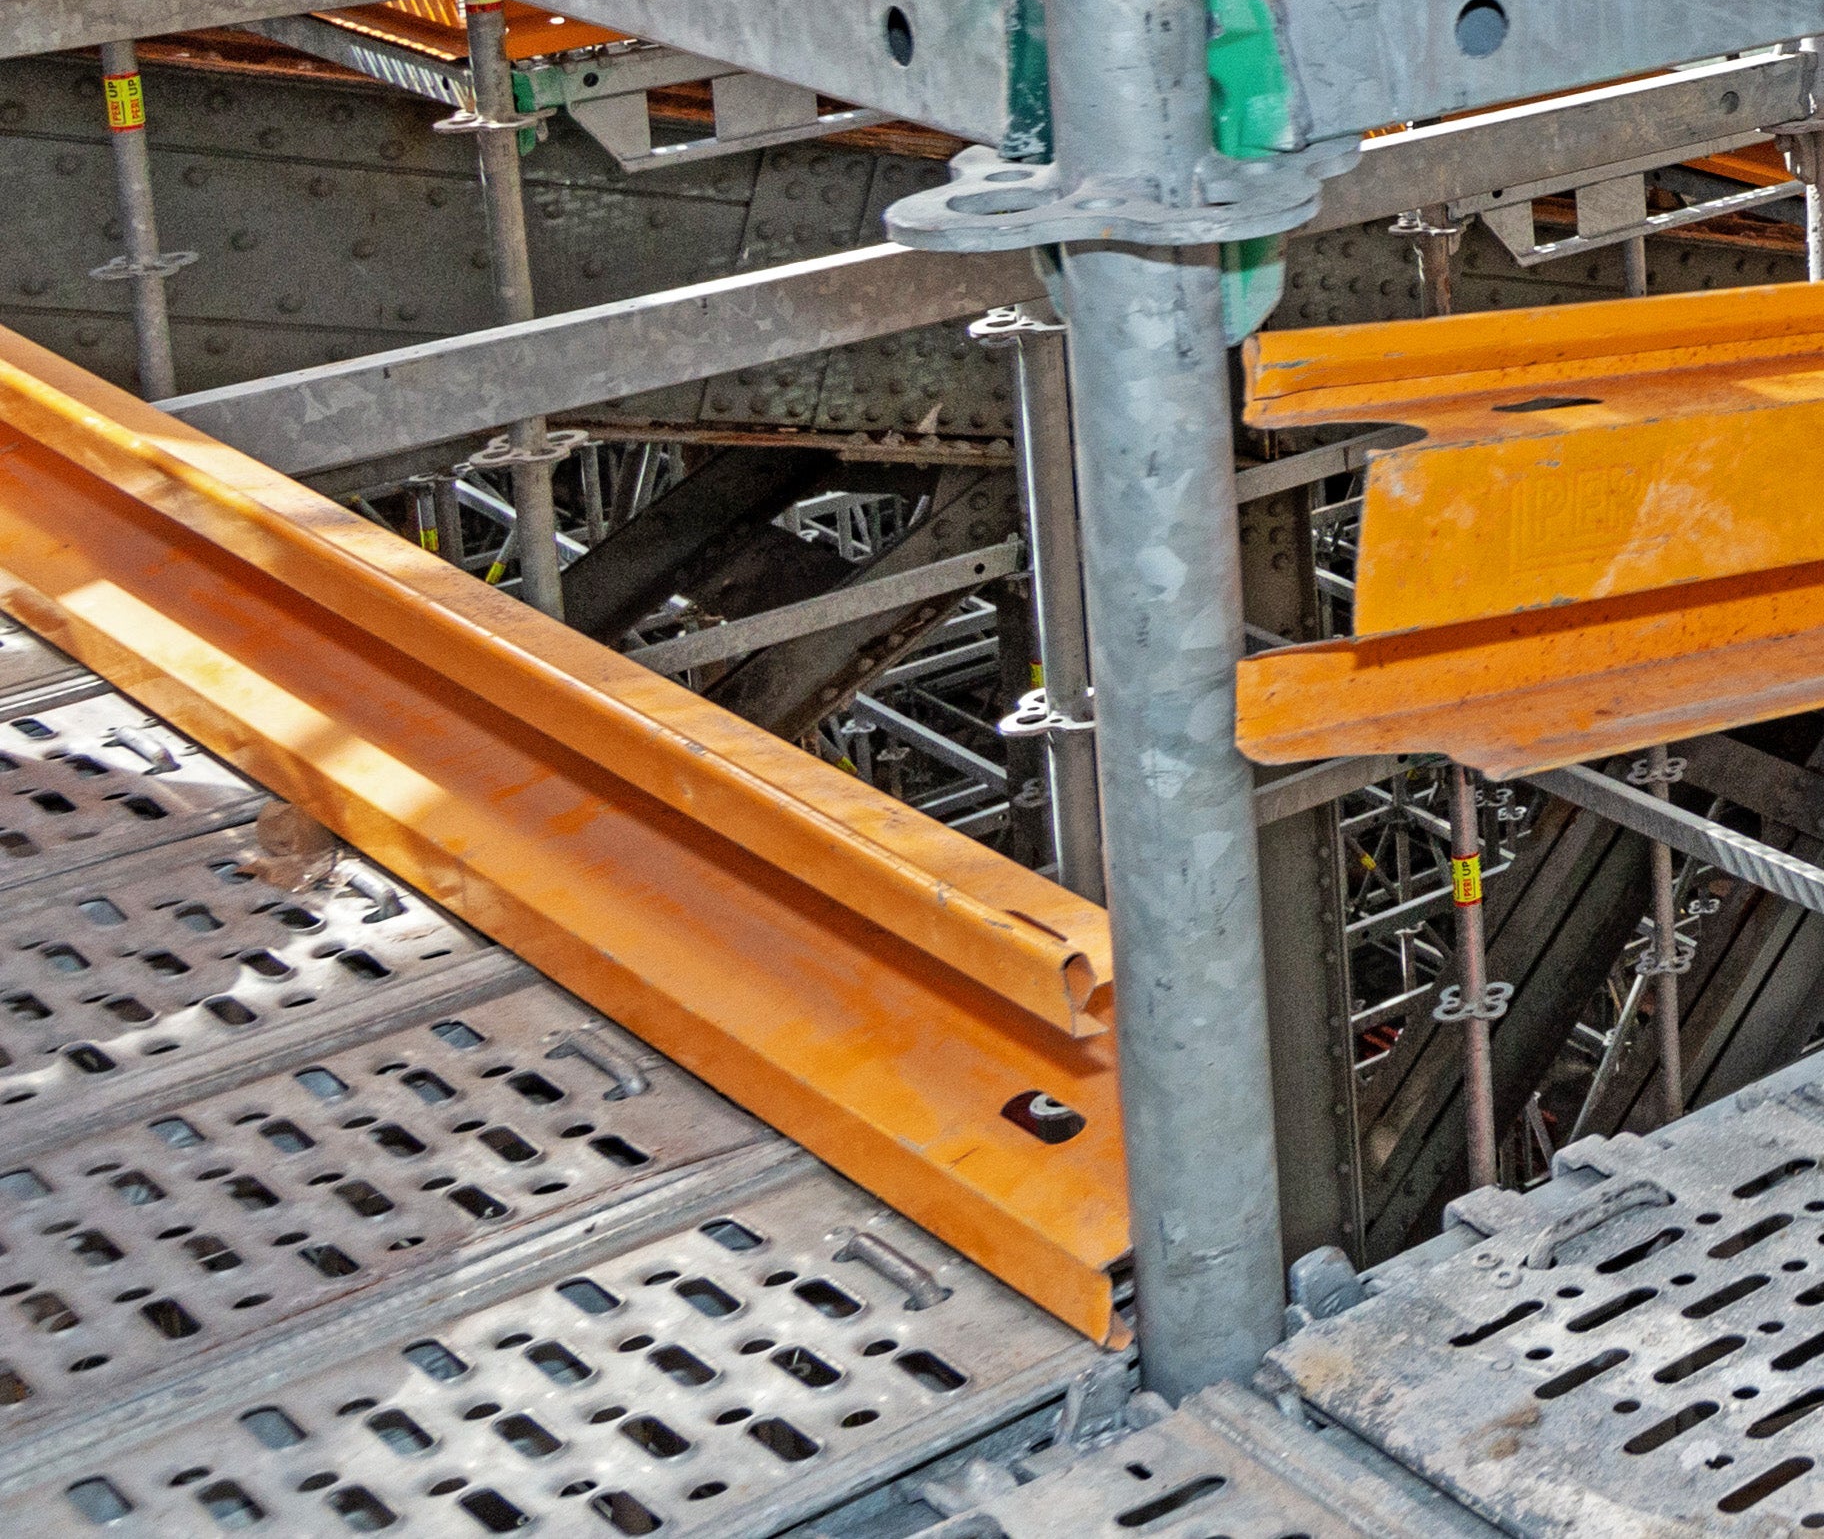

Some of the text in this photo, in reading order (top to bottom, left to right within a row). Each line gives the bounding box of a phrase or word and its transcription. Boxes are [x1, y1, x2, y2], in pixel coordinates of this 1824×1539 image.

[108, 81, 121, 121] PERI UP
[128, 79, 141, 119] PERI UP
[1461, 861, 1473, 897] PERI UP
